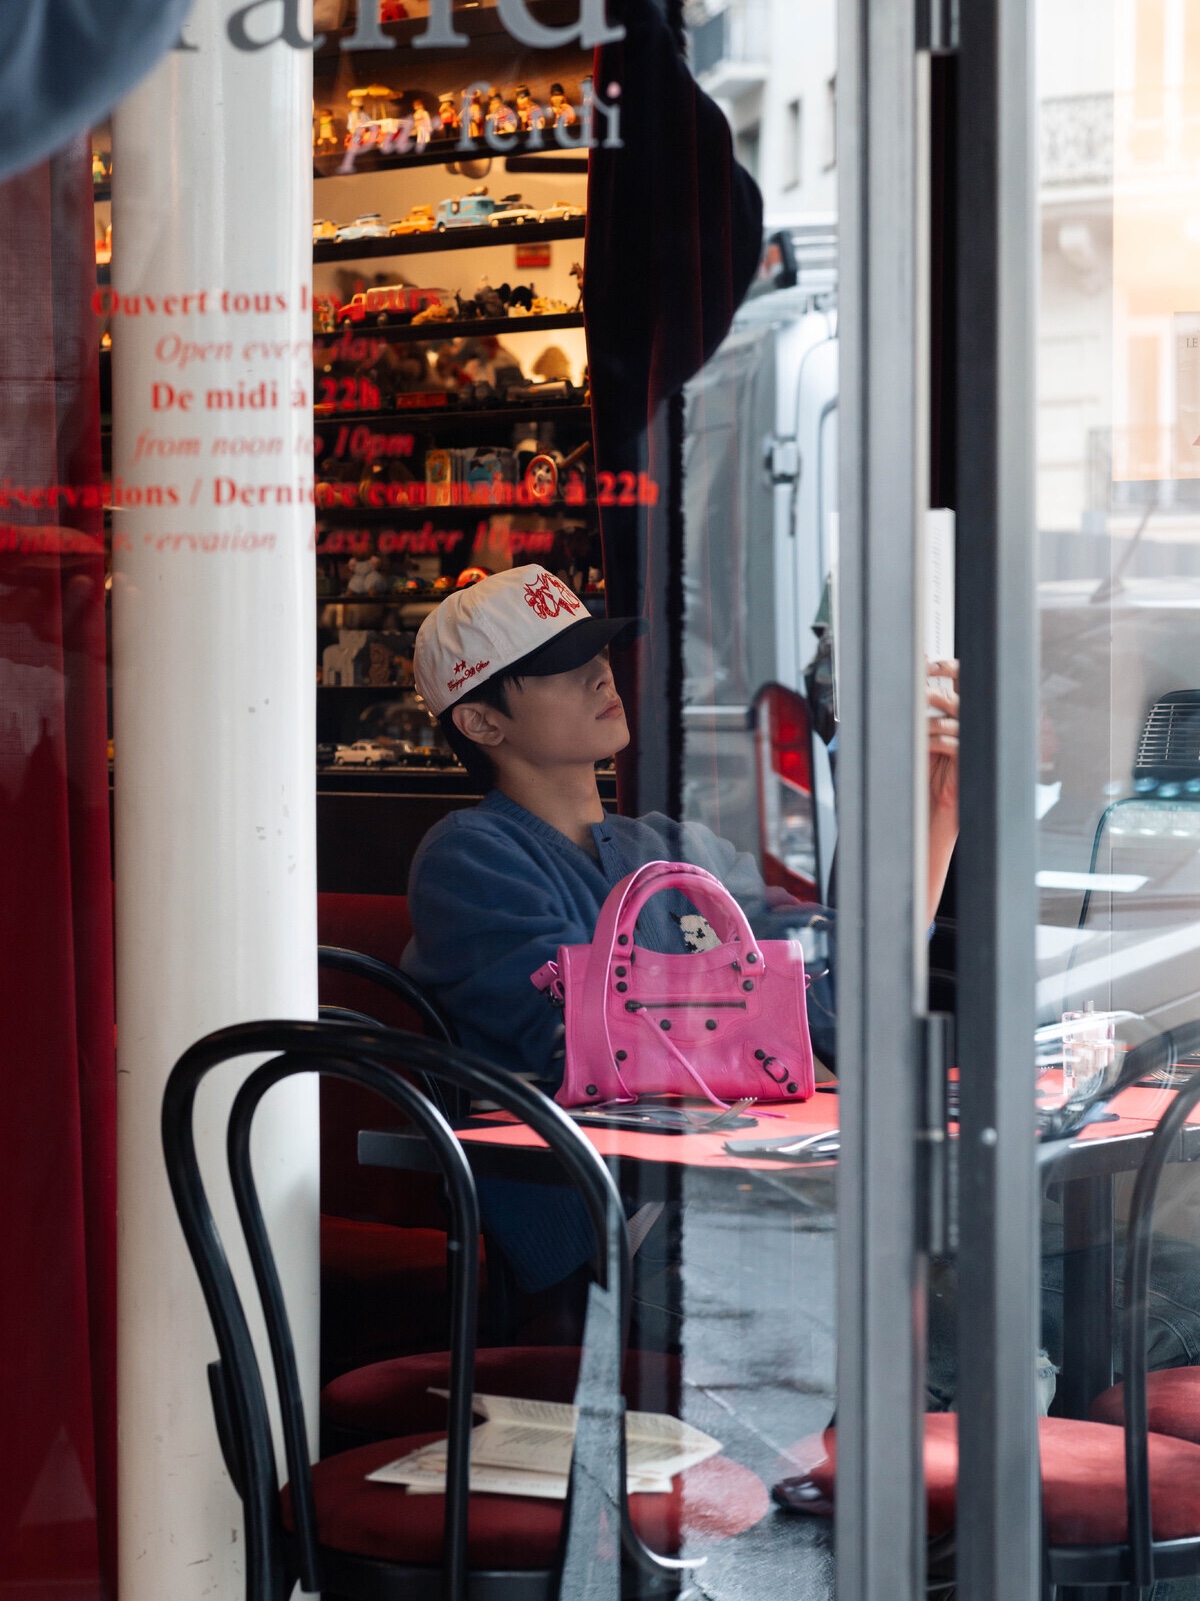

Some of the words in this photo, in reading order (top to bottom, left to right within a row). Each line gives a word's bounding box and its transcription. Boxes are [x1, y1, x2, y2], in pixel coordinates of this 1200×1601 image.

[454, 80, 625, 150] ferdi
[90, 286, 208, 317] Ouvert
[221, 288, 287, 314] tous
[155, 333, 234, 370] Open
[151, 382, 194, 412] De
[205, 379, 279, 412] midi
[289, 378, 308, 409] à
[319, 376, 381, 412] 22h
[130, 427, 202, 467] from
[211, 436, 283, 458] noon
[295, 431, 325, 458] to
[333, 425, 415, 464] 10pm
[596, 470, 660, 508] 22h
[472, 520, 555, 561] 10pm
